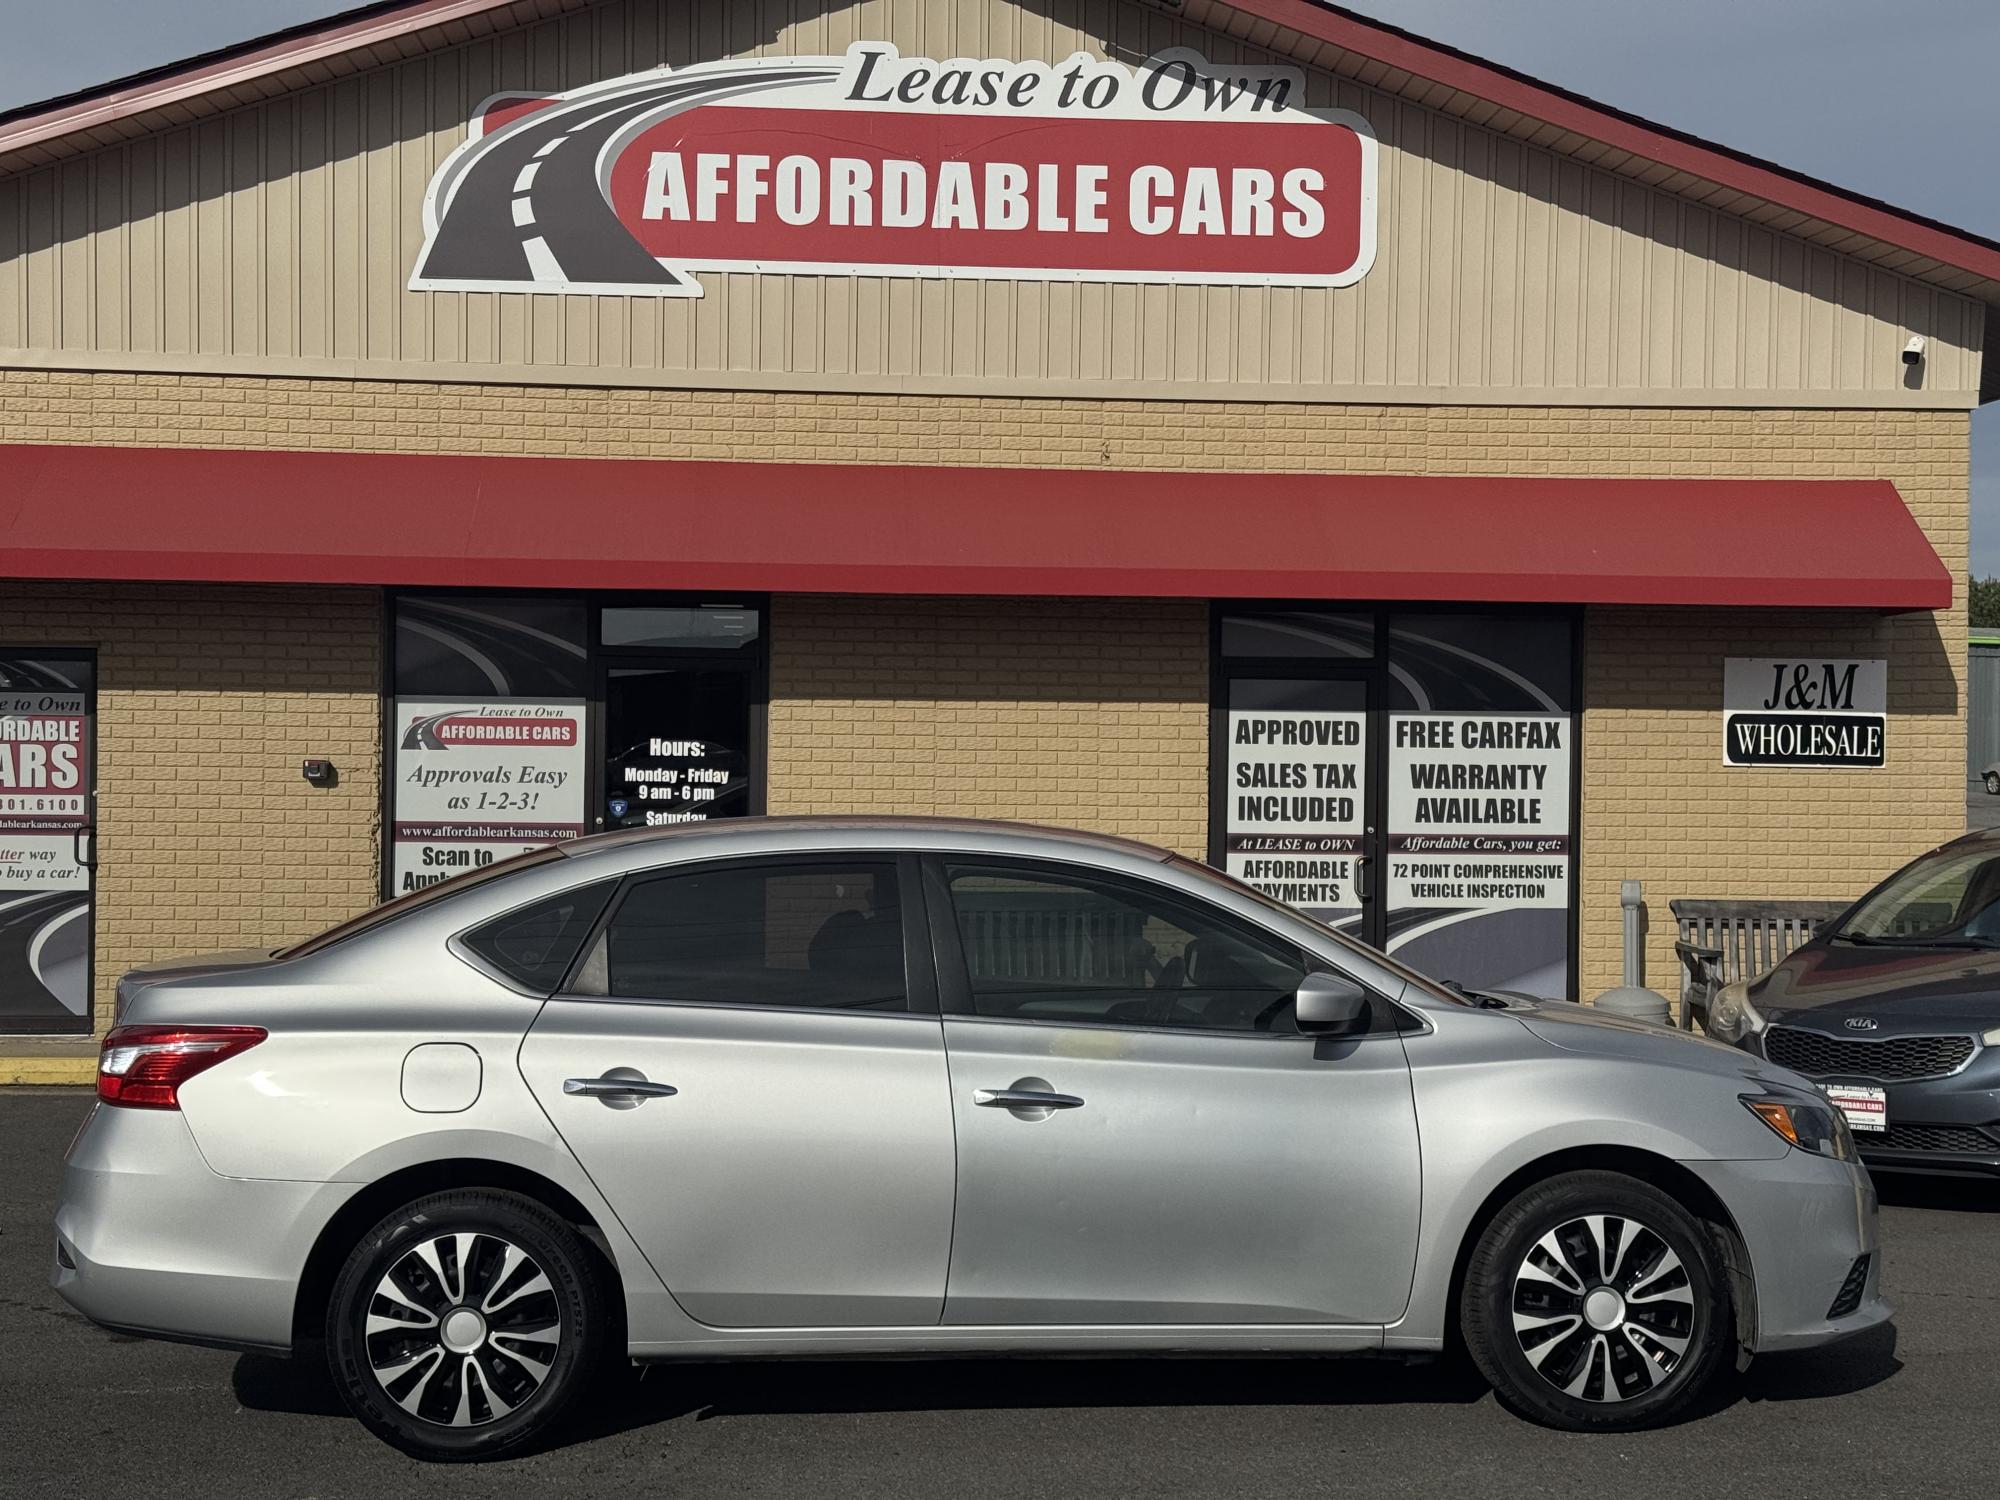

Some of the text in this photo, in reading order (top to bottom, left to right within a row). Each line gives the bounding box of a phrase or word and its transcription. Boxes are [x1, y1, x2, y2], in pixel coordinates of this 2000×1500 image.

[844, 51, 1292, 113] Lease to Own
[642, 151, 1328, 239] AFFORDABLE CARS
[1763, 664, 1859, 710] J&M
[14, 699, 31, 711] to
[39, 697, 81, 711] Own
[479, 706, 564, 718] Lease to Own
[441, 725, 571, 741] AFFORDABLE CARS
[1235, 719, 1360, 746] APPROVED
[1396, 721, 1561, 749] FREE CARFAX
[1735, 723, 1881, 757] WHOLESALE
[650, 738, 705, 757] Hours:
[406, 764, 568, 789] Approvals Easy
[624, 767, 678, 784] Monday
[687, 768, 729, 784] Friday
[1236, 762, 1357, 789] SALES TAX
[1410, 763, 1547, 790] WARRANTY
[448, 792, 539, 810] as 1-2-3!
[638, 785, 648, 799] 9
[651, 787, 671, 799] am
[682, 785, 691, 800] 6
[693, 787, 715, 801] pm
[1238, 796, 1354, 822] INCLUDED
[1415, 797, 1541, 824] AVAILABLE
[402, 826, 577, 839] www.affordablearkansas.com
[1237, 838, 1356, 851] At LEASE to OWN
[1401, 837, 1562, 852] Affordable Cars, you get:
[29, 850, 56, 863] way
[422, 846, 493, 867] Scan to
[7, 866, 33, 881] buy
[37, 869, 46, 878] a
[50, 866, 80, 878] car!
[1243, 860, 1348, 879] AFFORDABLE
[1393, 864, 1563, 879] 72 POINT COMPREHENSIVE
[1411, 884, 1545, 899] VEHICLE INSPECTION
[1848, 1018, 1872, 1028] KIA
